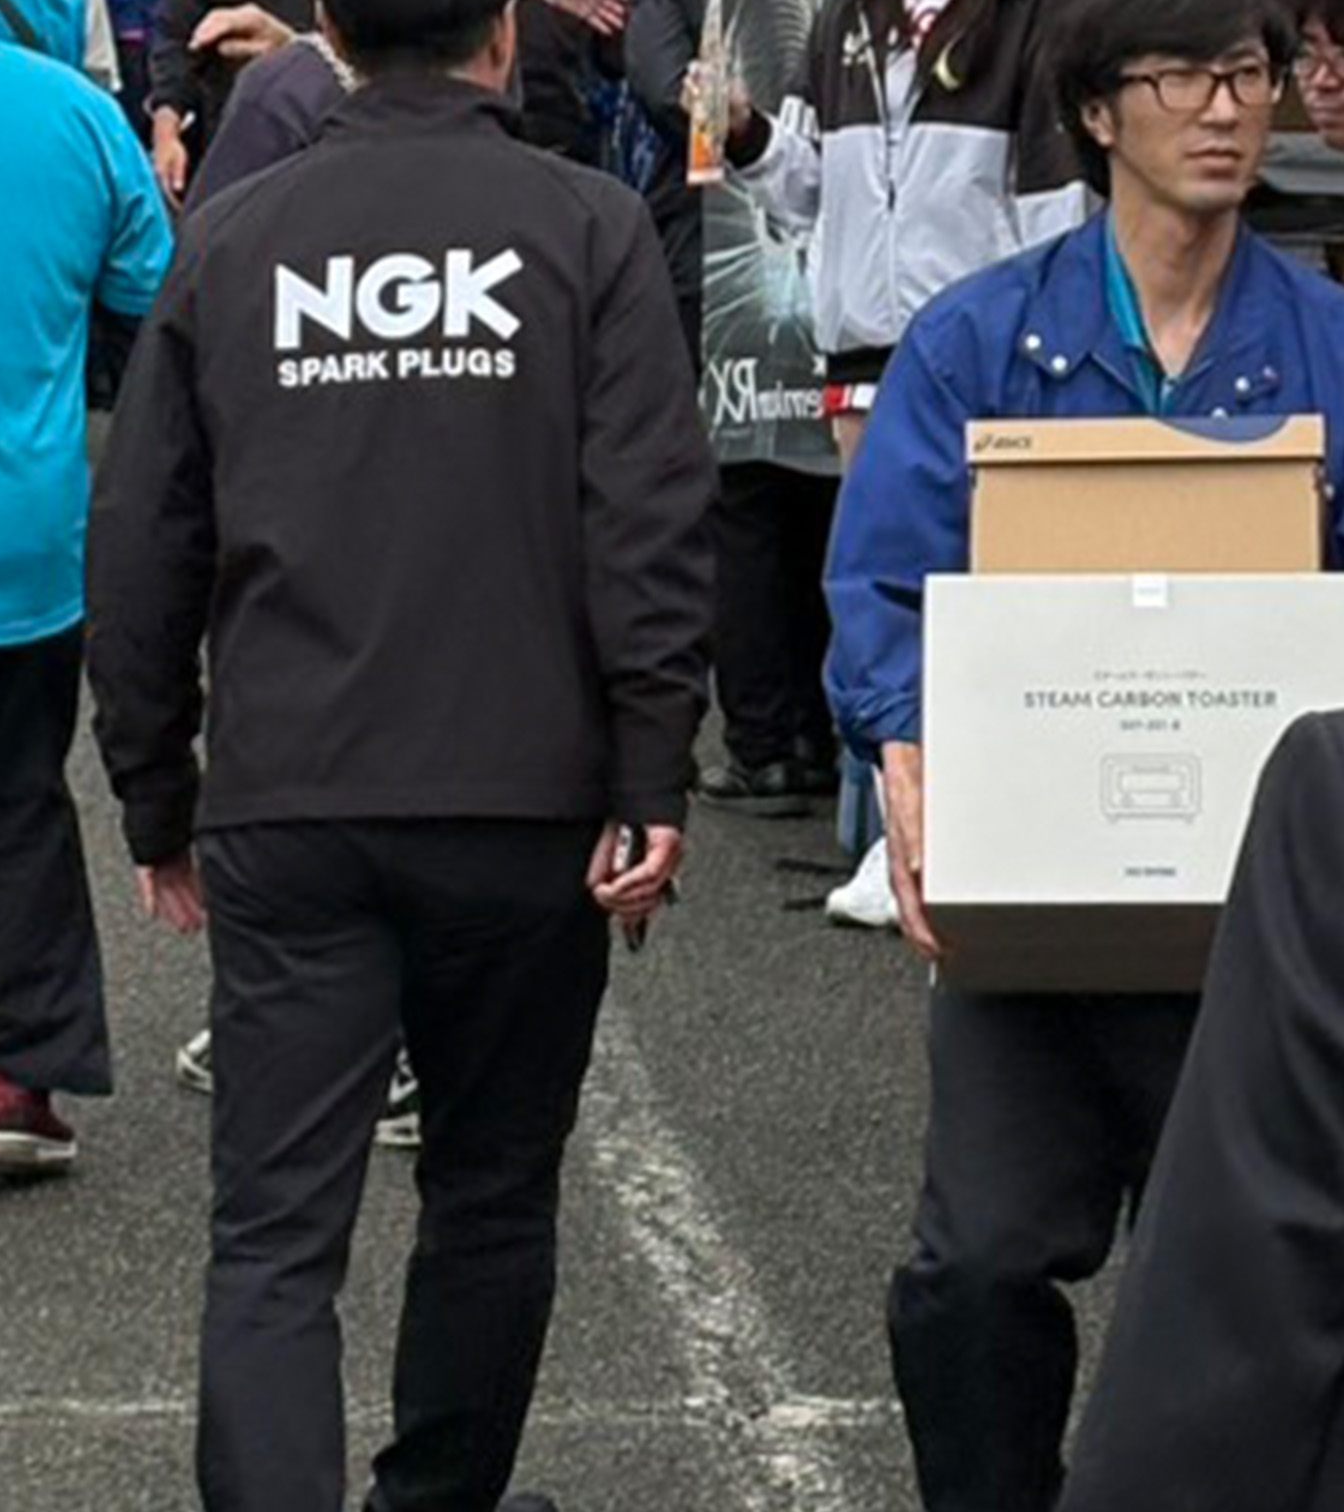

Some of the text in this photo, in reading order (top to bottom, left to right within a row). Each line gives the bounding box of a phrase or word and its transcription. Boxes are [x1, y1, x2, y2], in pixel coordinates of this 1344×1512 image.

[274, 247, 524, 350] NGK
[278, 348, 515, 387] SPARK PLUGS
[1023, 690, 1277, 709] STEAM CARBON TOASTER
